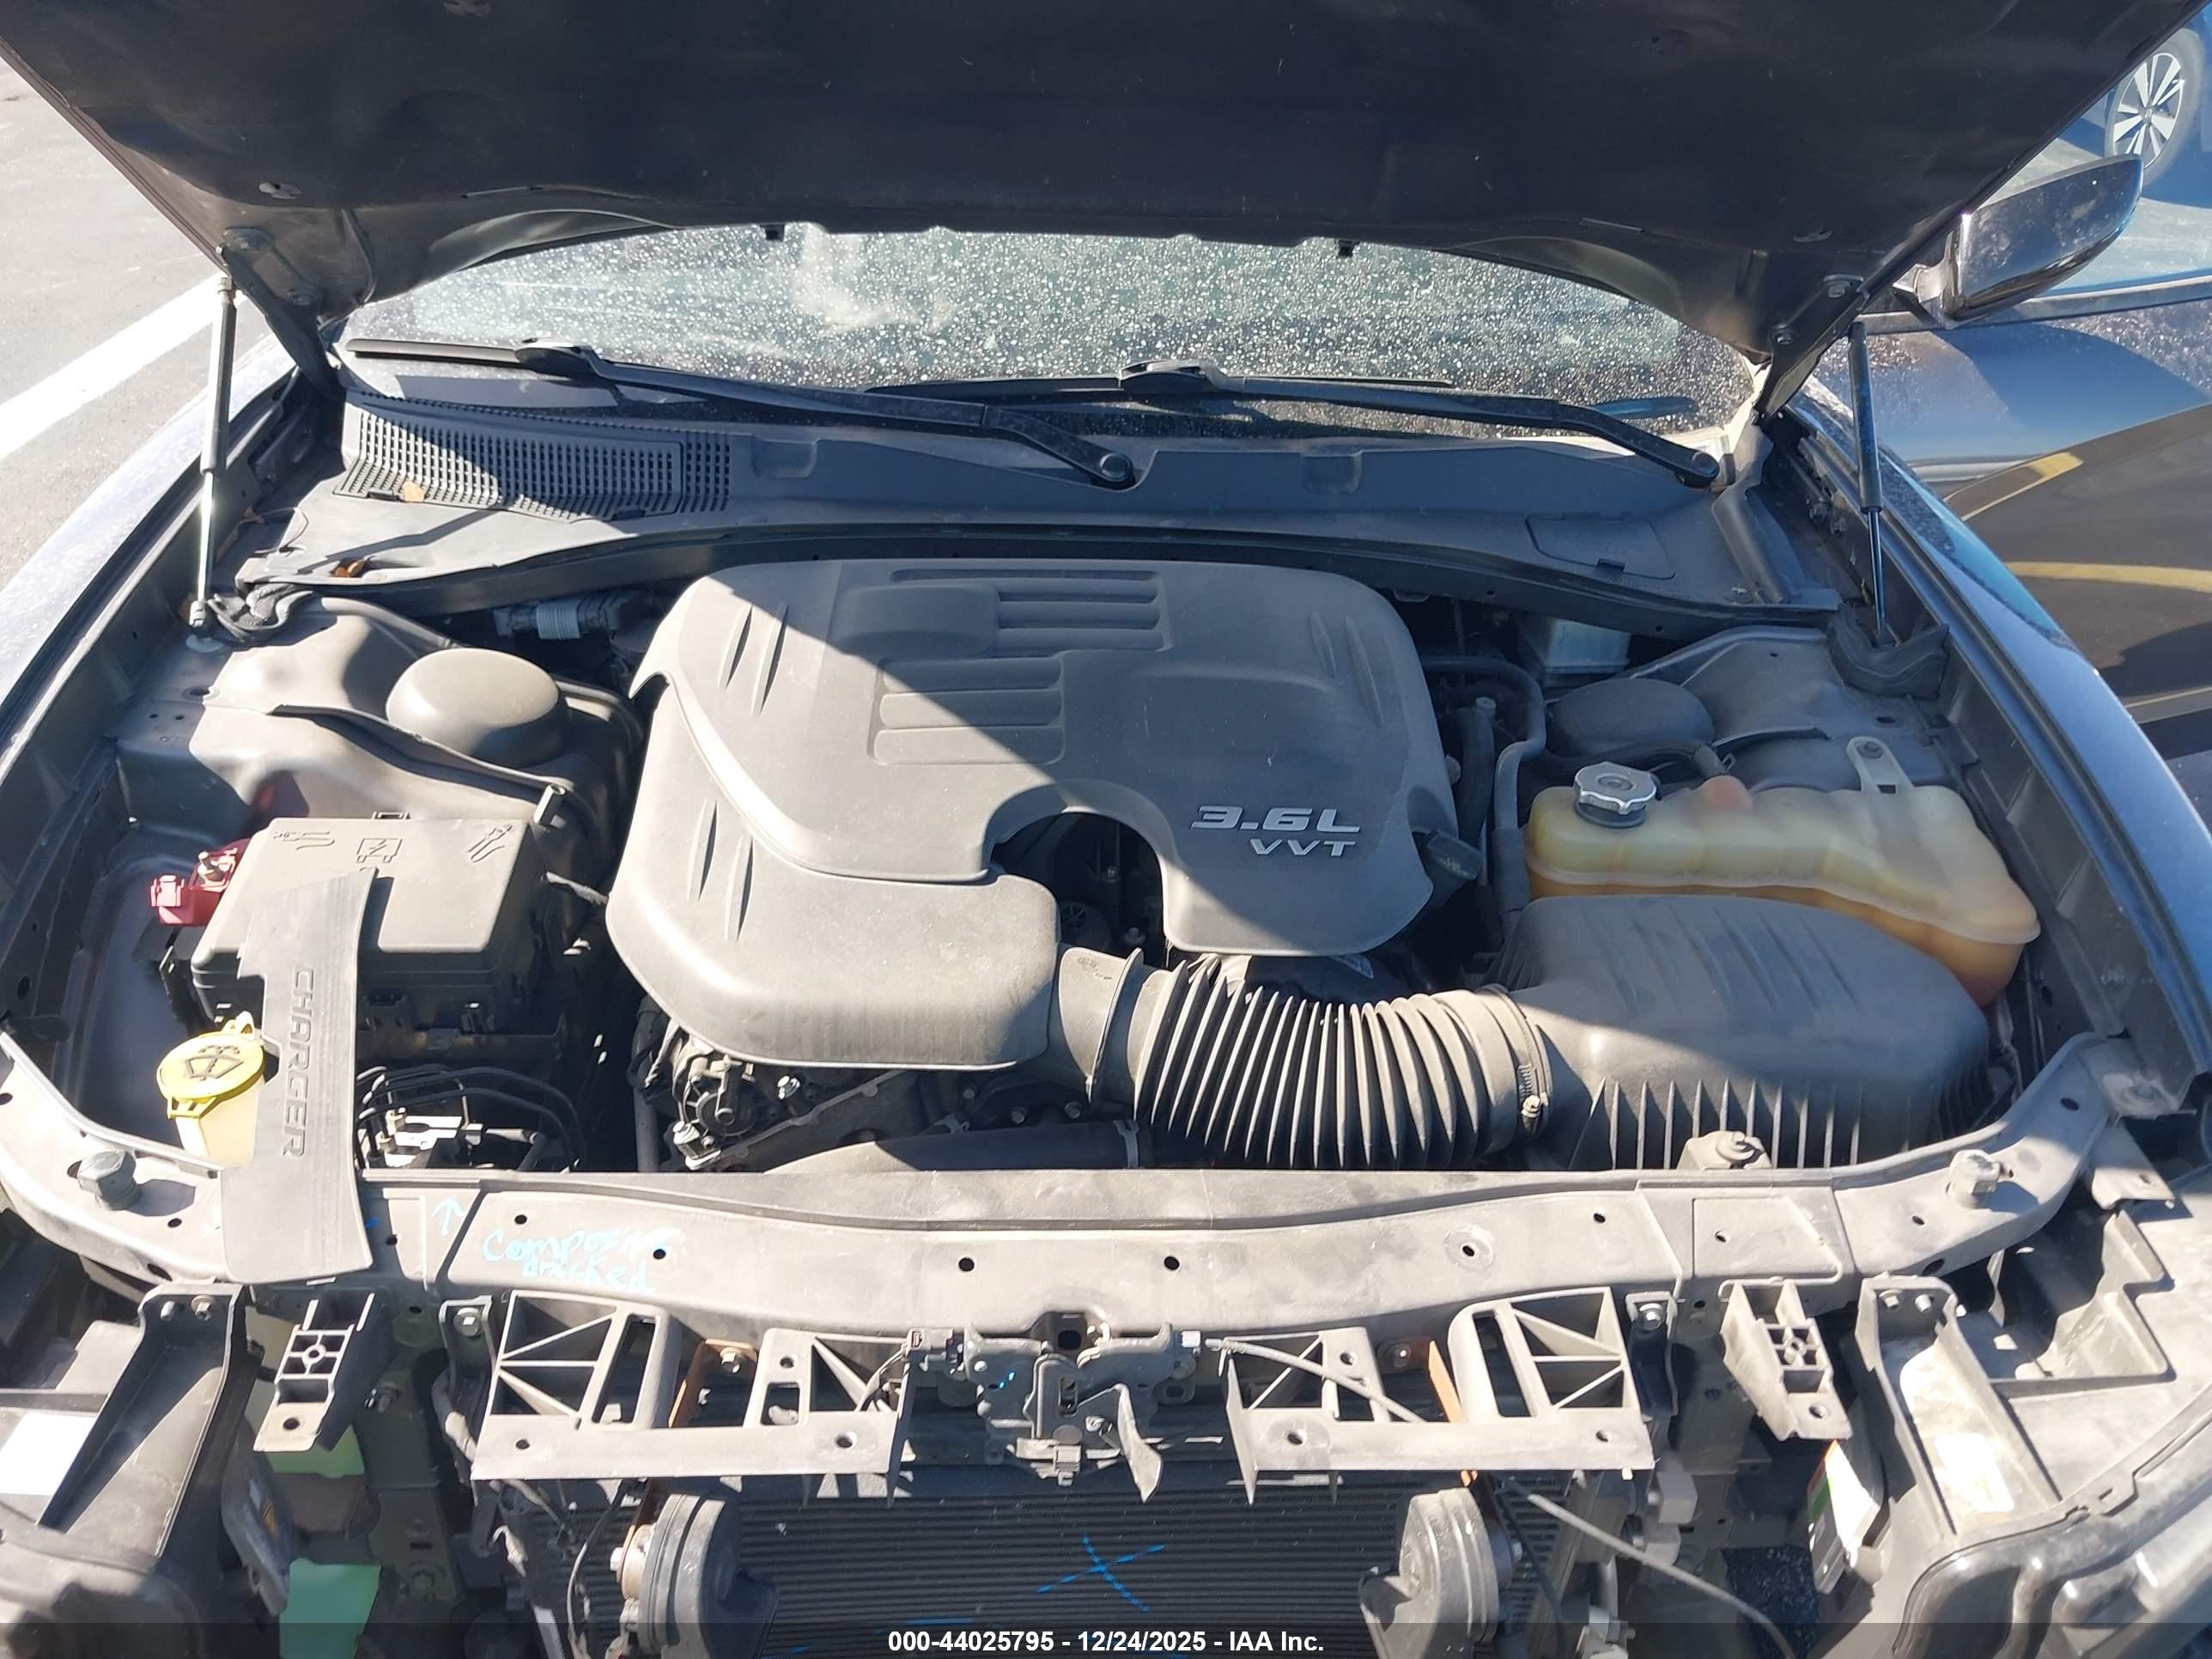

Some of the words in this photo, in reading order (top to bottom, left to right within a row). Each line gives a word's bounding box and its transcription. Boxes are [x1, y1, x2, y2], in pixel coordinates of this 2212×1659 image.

[1190, 805, 1361, 833] 3.6L
[1249, 838, 1357, 857] VVT
[282, 966, 314, 1158] CHARGER
